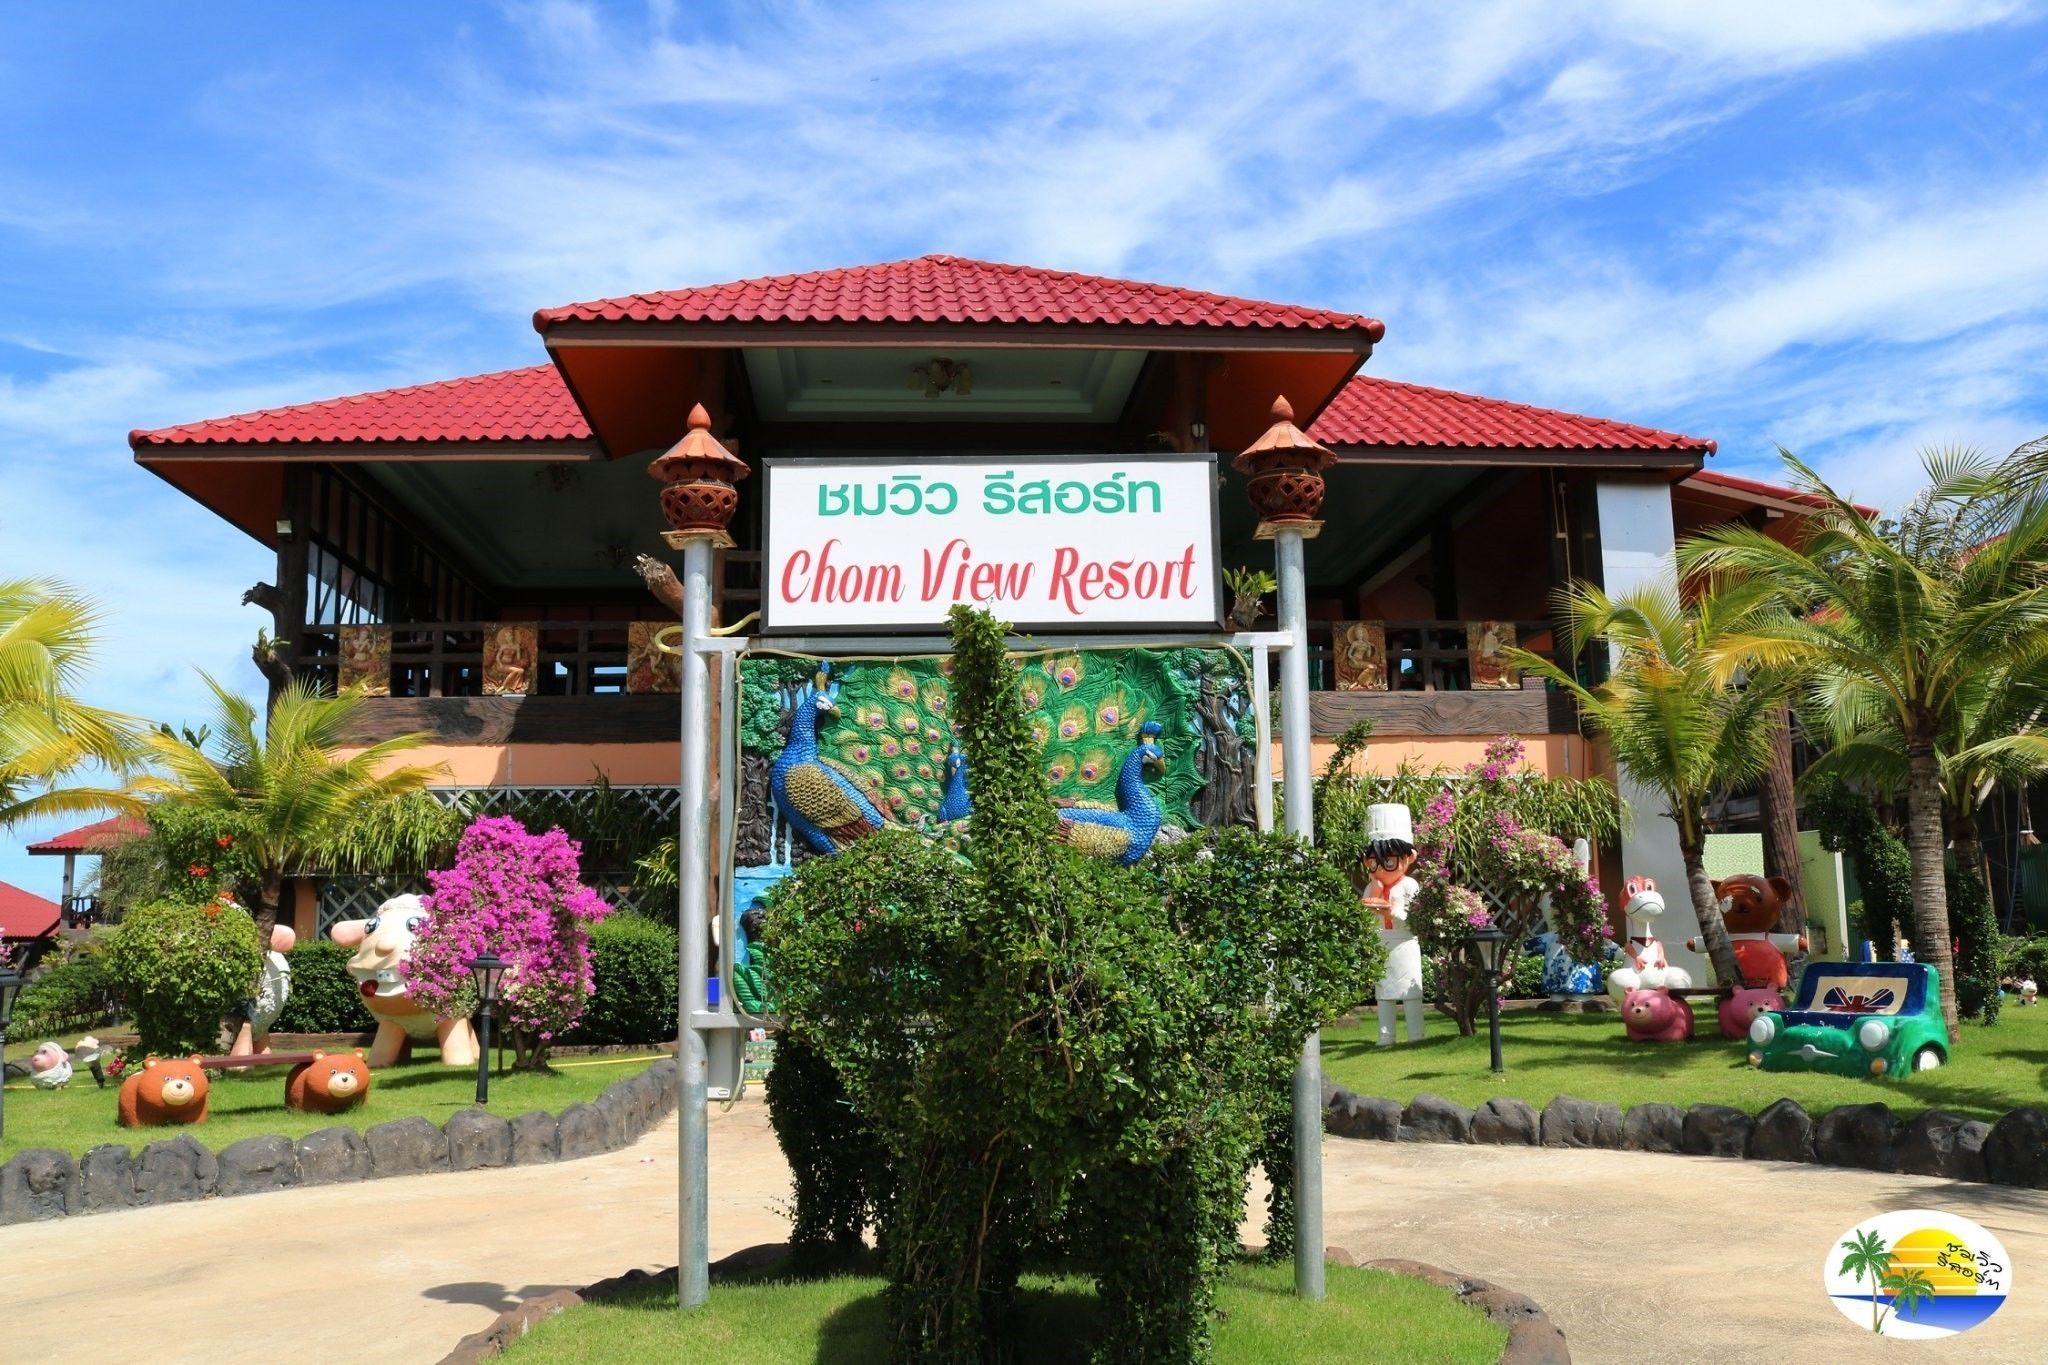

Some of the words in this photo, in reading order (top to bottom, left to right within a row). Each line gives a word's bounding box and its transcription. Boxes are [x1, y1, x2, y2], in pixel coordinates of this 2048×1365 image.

[818, 475, 958, 516] ชมวิว
[982, 470, 1162, 515] รีสอร์ท
[781, 538, 906, 604] Chom
[920, 538, 1036, 602] View
[1048, 543, 1198, 616] Resort
